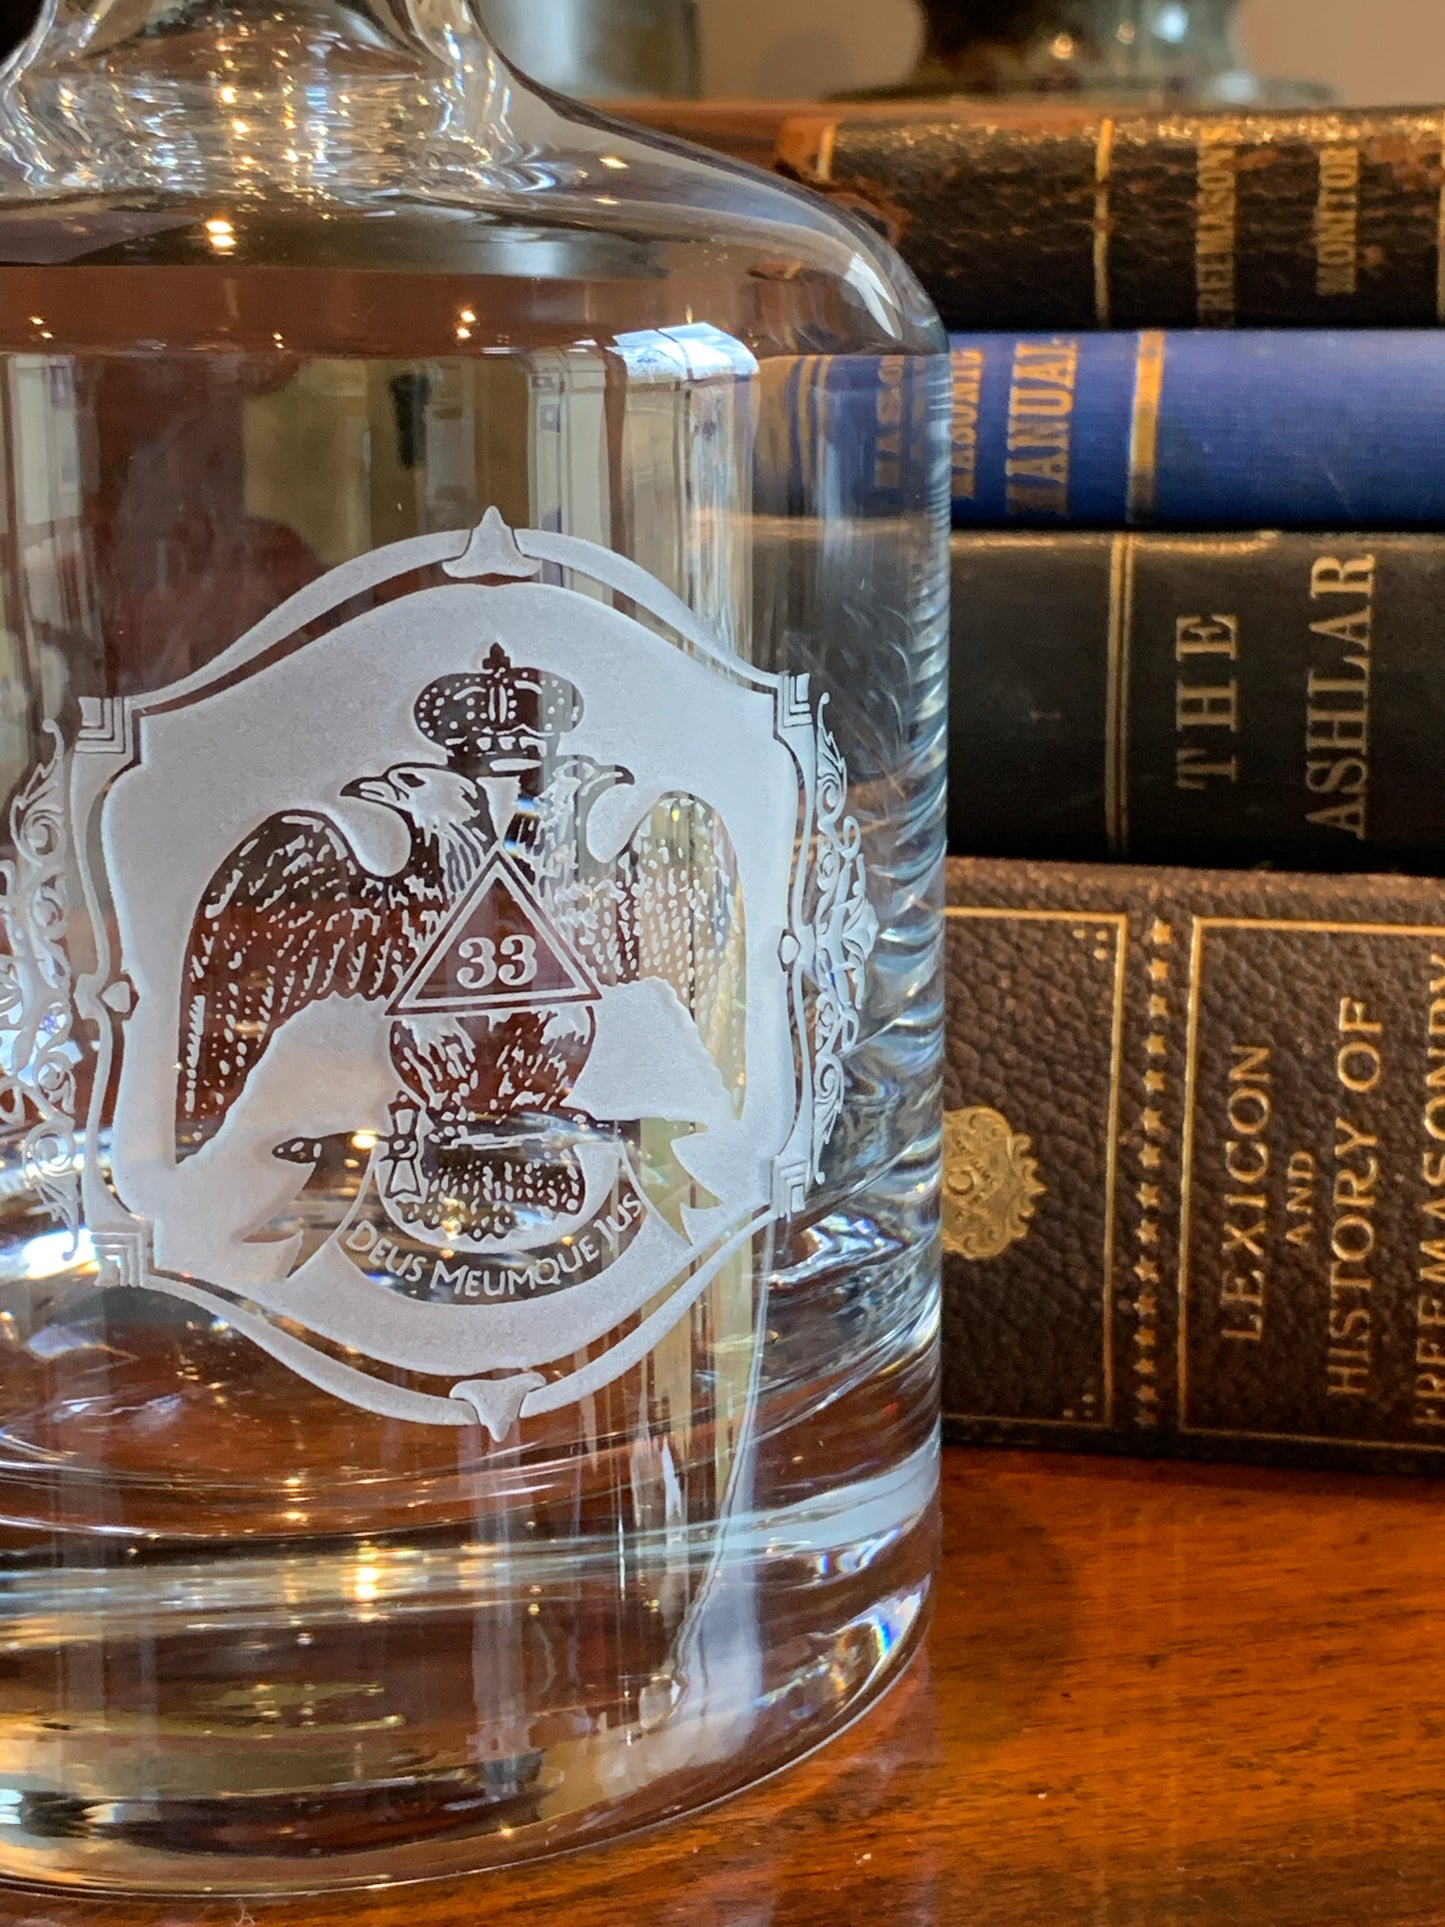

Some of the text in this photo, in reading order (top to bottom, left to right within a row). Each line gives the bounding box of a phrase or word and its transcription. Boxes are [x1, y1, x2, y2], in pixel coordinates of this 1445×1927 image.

[1197, 125, 1236, 326] REEMASON'S
[1316, 148, 1358, 295] MONITOR
[1006, 338, 1077, 516] MANUAL
[1176, 614, 1238, 790] THE
[1305, 554, 1375, 841] ASHLAR
[456, 933, 538, 989] 33
[345, 1192, 643, 1297] DEUS MEUMQUE JUS
[1221, 1045, 1271, 1342] LEXICON
[1285, 1150, 1315, 1247] AND
[1327, 997, 1382, 1396] HISTORY OF
